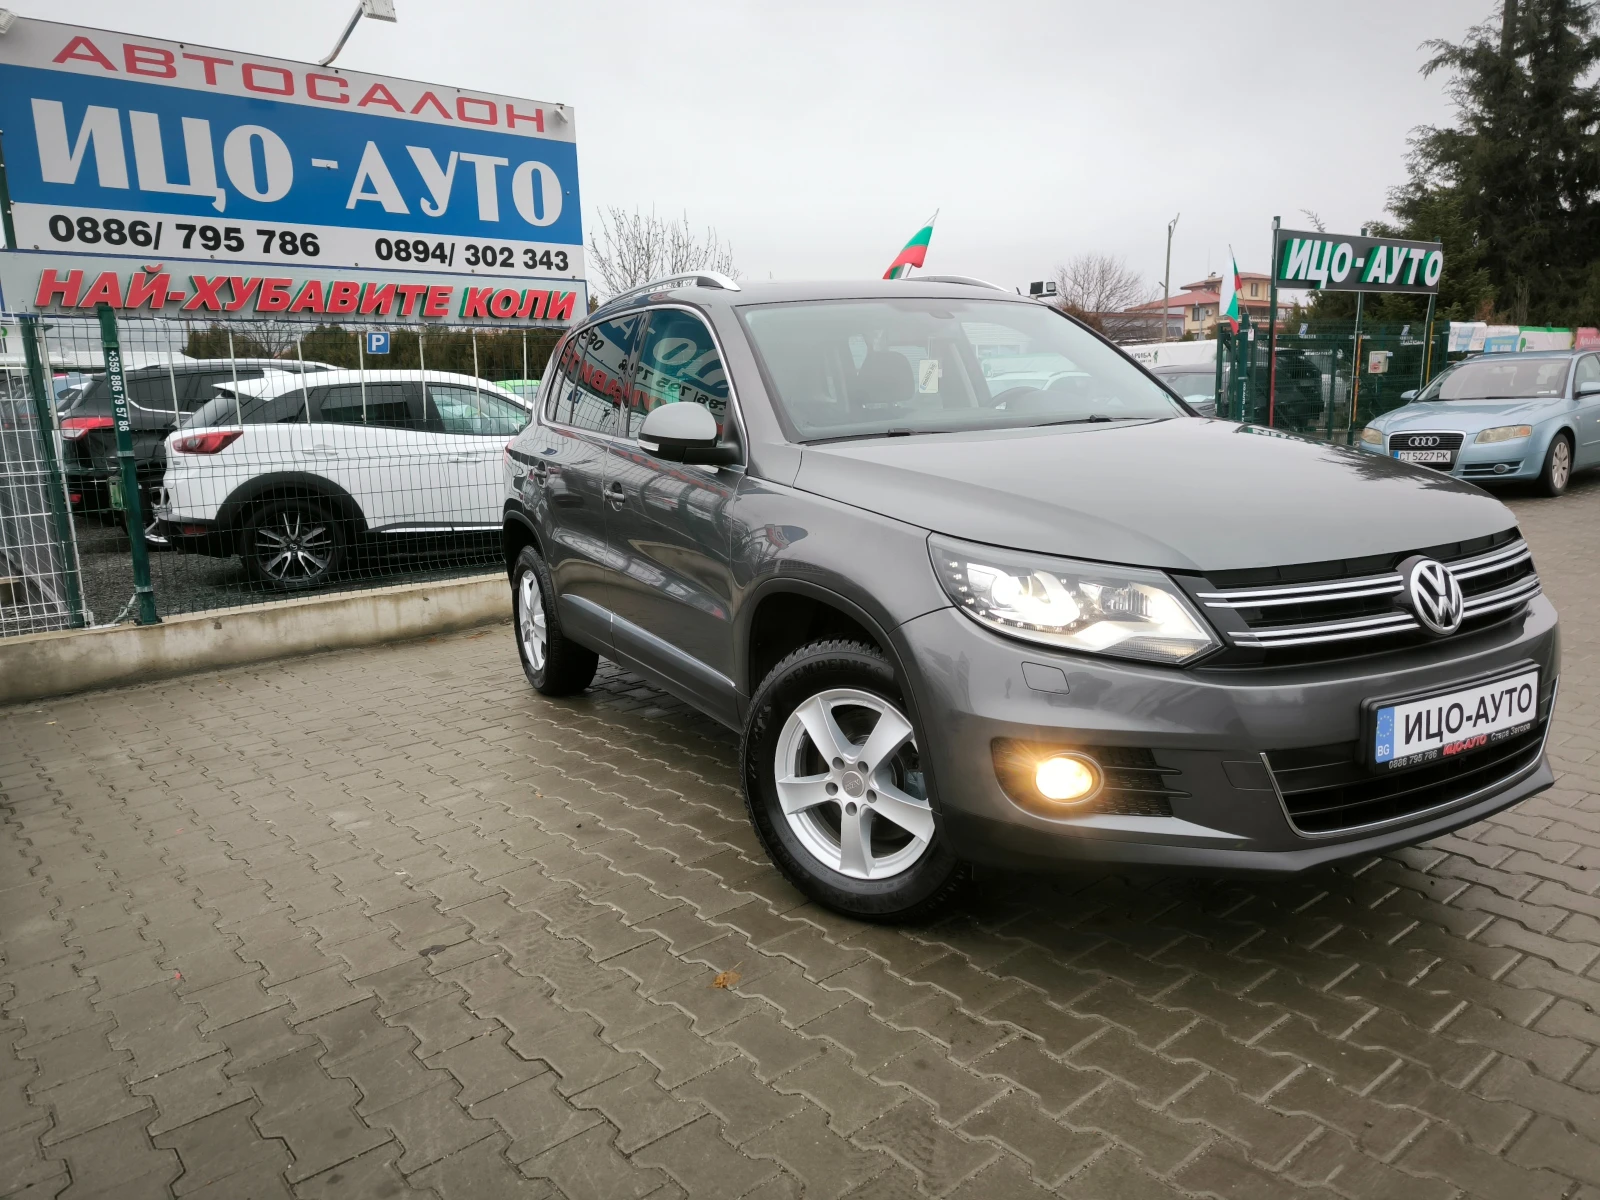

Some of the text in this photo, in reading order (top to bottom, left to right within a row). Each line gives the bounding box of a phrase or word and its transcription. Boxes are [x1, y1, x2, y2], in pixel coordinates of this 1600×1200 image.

[52, 36, 545, 133] АВТОСАЛОН
[49, 214, 320, 257] 0886/ 795 786
[374, 238, 569, 272] 0894/ 302 343
[1281, 238, 1443, 289] ИЦО-АУТО
[34, 262, 577, 320] НАЙ-ХУБАВИТЕ КОЛИ
[108, 350, 130, 432] +359 886 79 57 86
[1413, 451, 1435, 461] 5227
[1437, 451, 1449, 461] PK
[1404, 683, 1533, 746] ИЦО-АУТО
[1377, 744, 1390, 757] BG
[1409, 752, 1422, 764] 795
[1424, 750, 1438, 761] 786
[1443, 734, 1488, 756] ИЦО-АУТО
